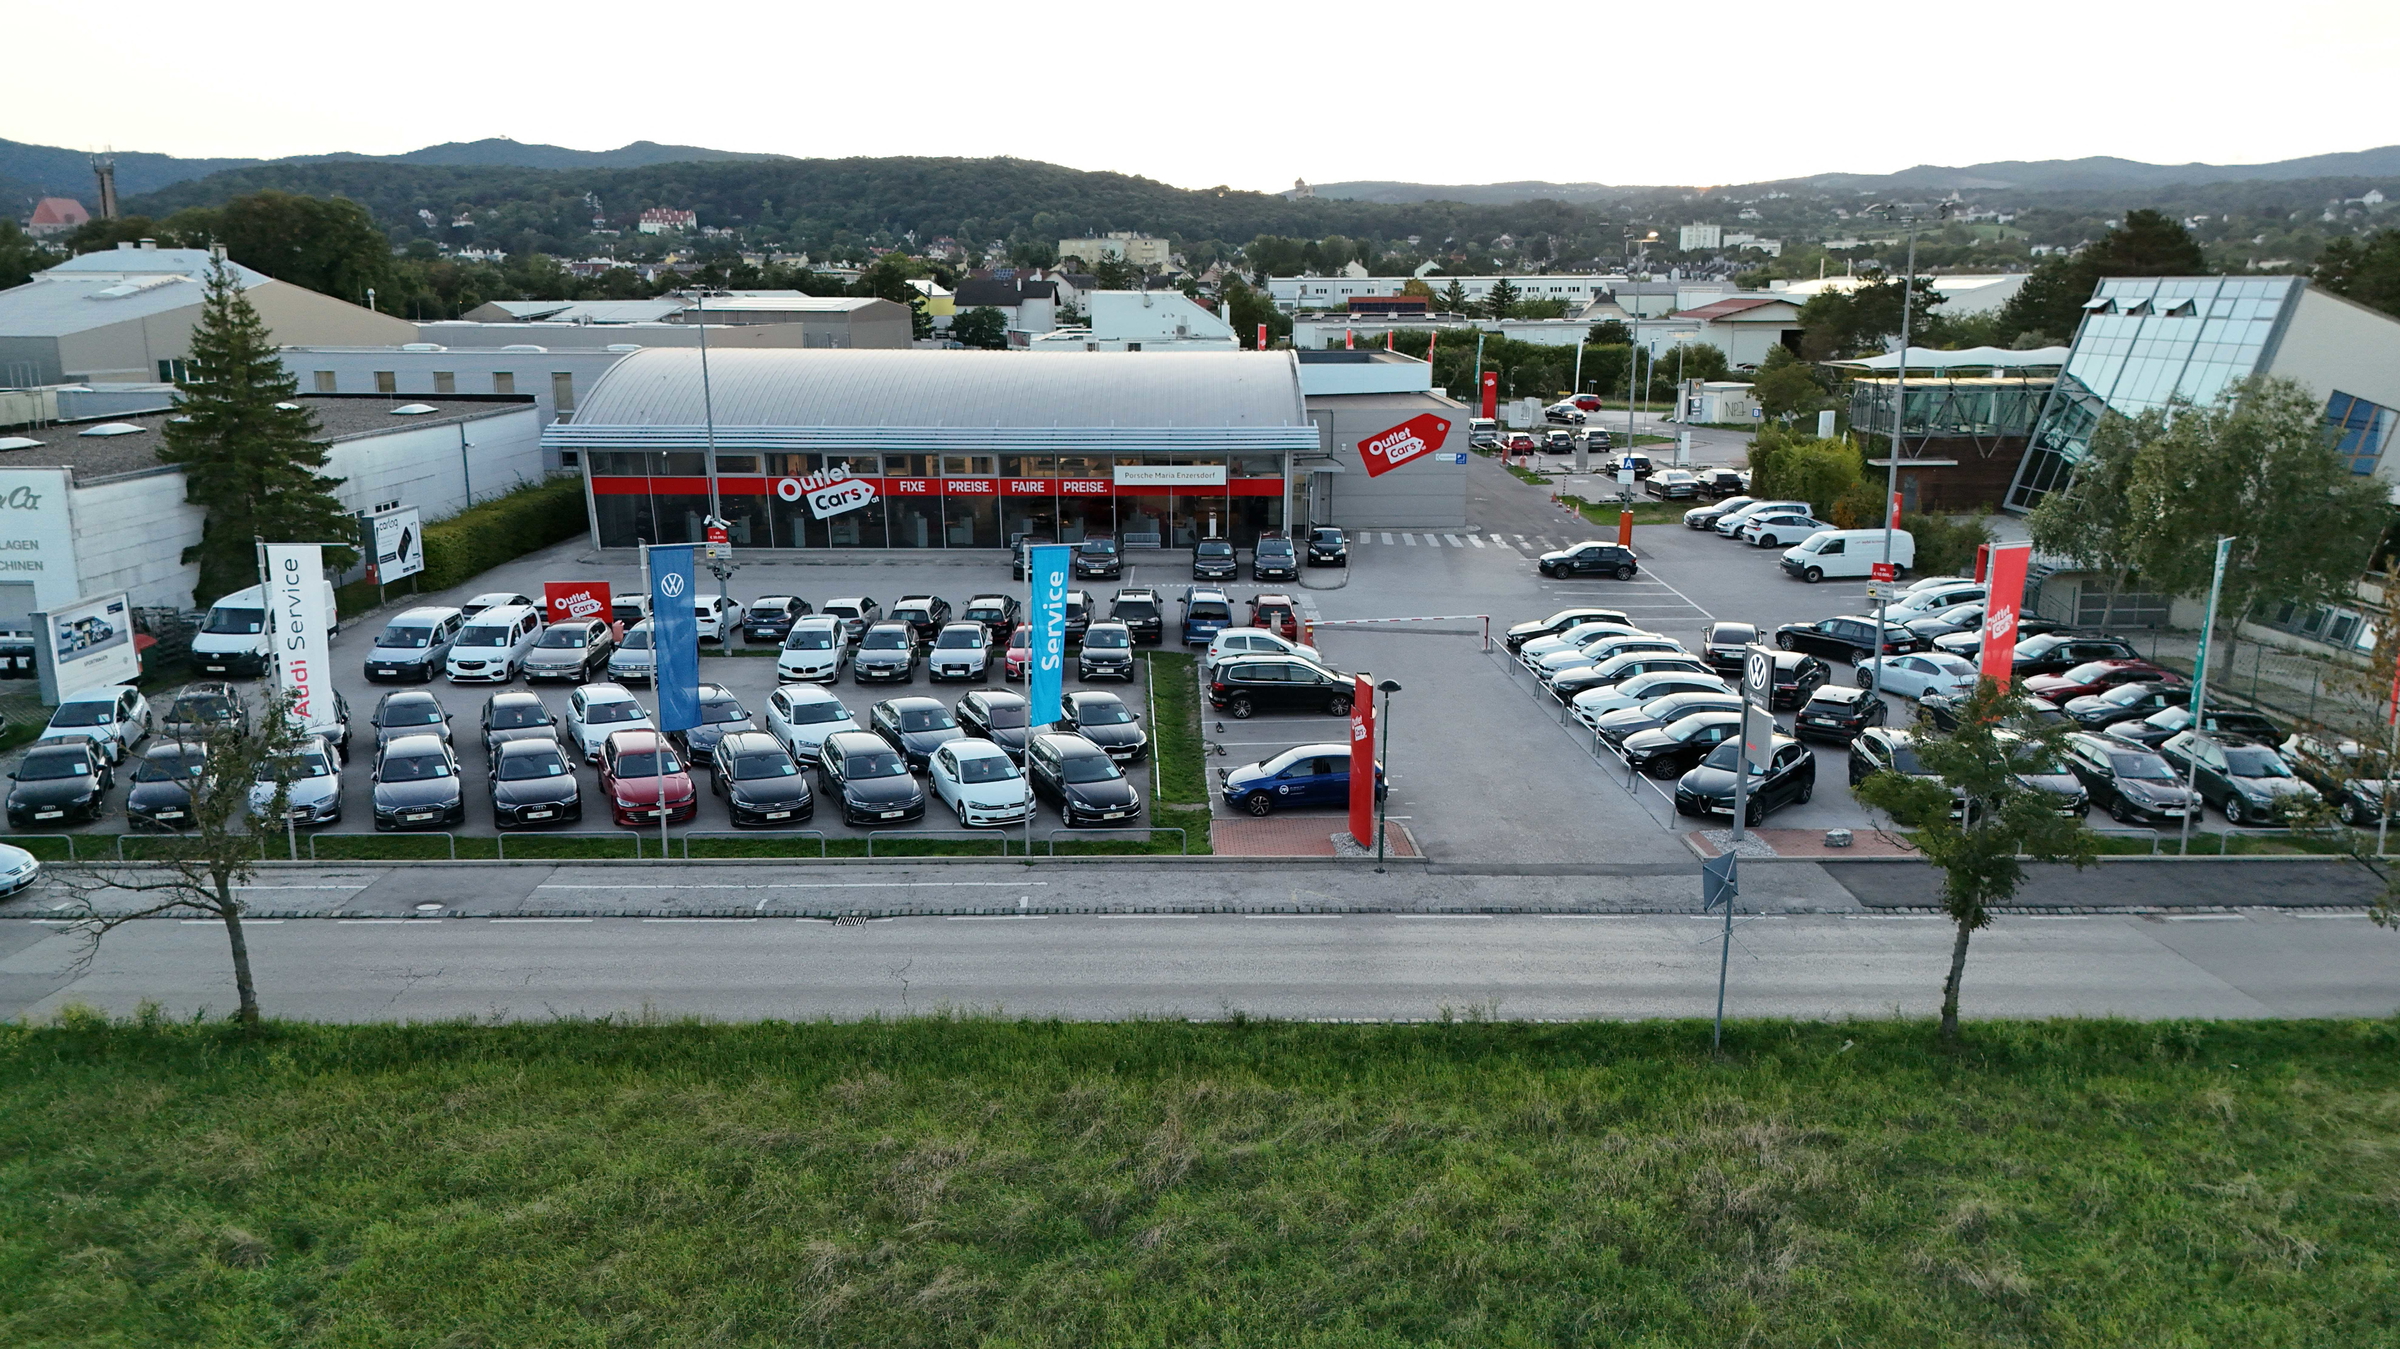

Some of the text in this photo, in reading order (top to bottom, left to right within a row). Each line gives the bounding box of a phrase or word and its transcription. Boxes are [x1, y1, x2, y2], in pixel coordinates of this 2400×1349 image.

[1369, 427, 1411, 456] Outlet
[1390, 442, 1417, 458] Cars
[1625, 459, 1632, 468] A
[777, 461, 851, 502] Outlet
[900, 481, 1108, 493] FIXE PREISE. FAIRE PREISE.
[815, 488, 862, 510] Cars
[555, 590, 591, 610] Outlet
[573, 603, 595, 613] Cars
[1041, 571, 1064, 670] Service
[282, 558, 312, 718] Audi Service
